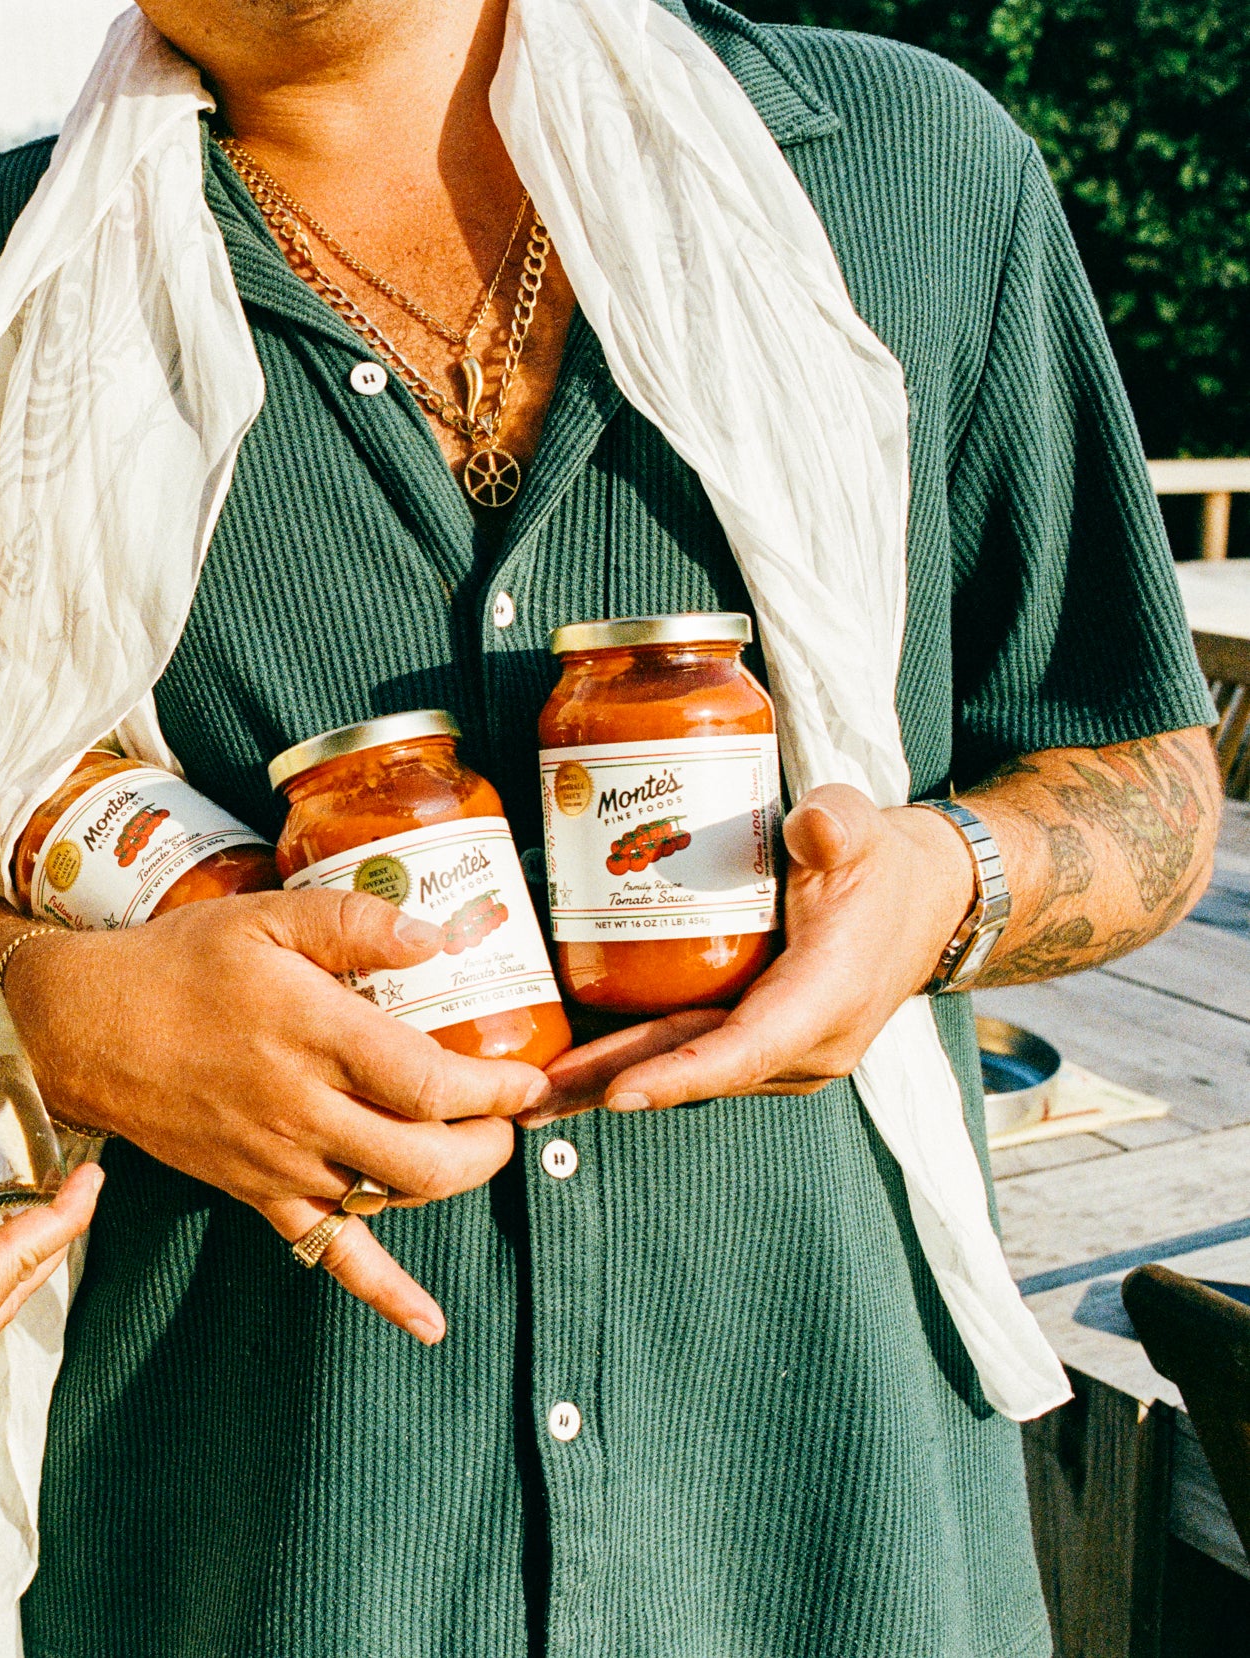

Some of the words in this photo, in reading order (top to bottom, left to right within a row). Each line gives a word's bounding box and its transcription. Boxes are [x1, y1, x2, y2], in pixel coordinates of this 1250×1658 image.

[98, 826, 116, 850] FINE
[116, 796, 144, 822] FOODS
[604, 812, 632, 827] FINE
[638, 796, 683, 815] FOODS
[752, 809, 762, 838] 100
[137, 850, 170, 882] Tomato
[173, 832, 203, 850] Sauce
[141, 846, 163, 865] Family
[142, 890, 155, 905] NET
[153, 876, 165, 888] WT
[165, 867, 174, 876] 16
[174, 858, 185, 868] OZ
[362, 874, 399, 891] OVERALL
[368, 867, 389, 879] BEST
[430, 891, 456, 910] FINE
[461, 870, 494, 892] FOODS
[622, 881, 652, 892] Family
[654, 880, 682, 889] Recipe
[609, 892, 654, 907] Tomato
[658, 890, 696, 903] Sauce
[595, 921, 611, 929] NET
[614, 920, 628, 928] WT
[631, 920, 641, 928] 16
[644, 919, 657, 928] OZ
[450, 966, 496, 987] Tomato
[500, 960, 526, 975] Sauce
[441, 1001, 459, 1013] NET
[462, 995, 477, 1007] WT
